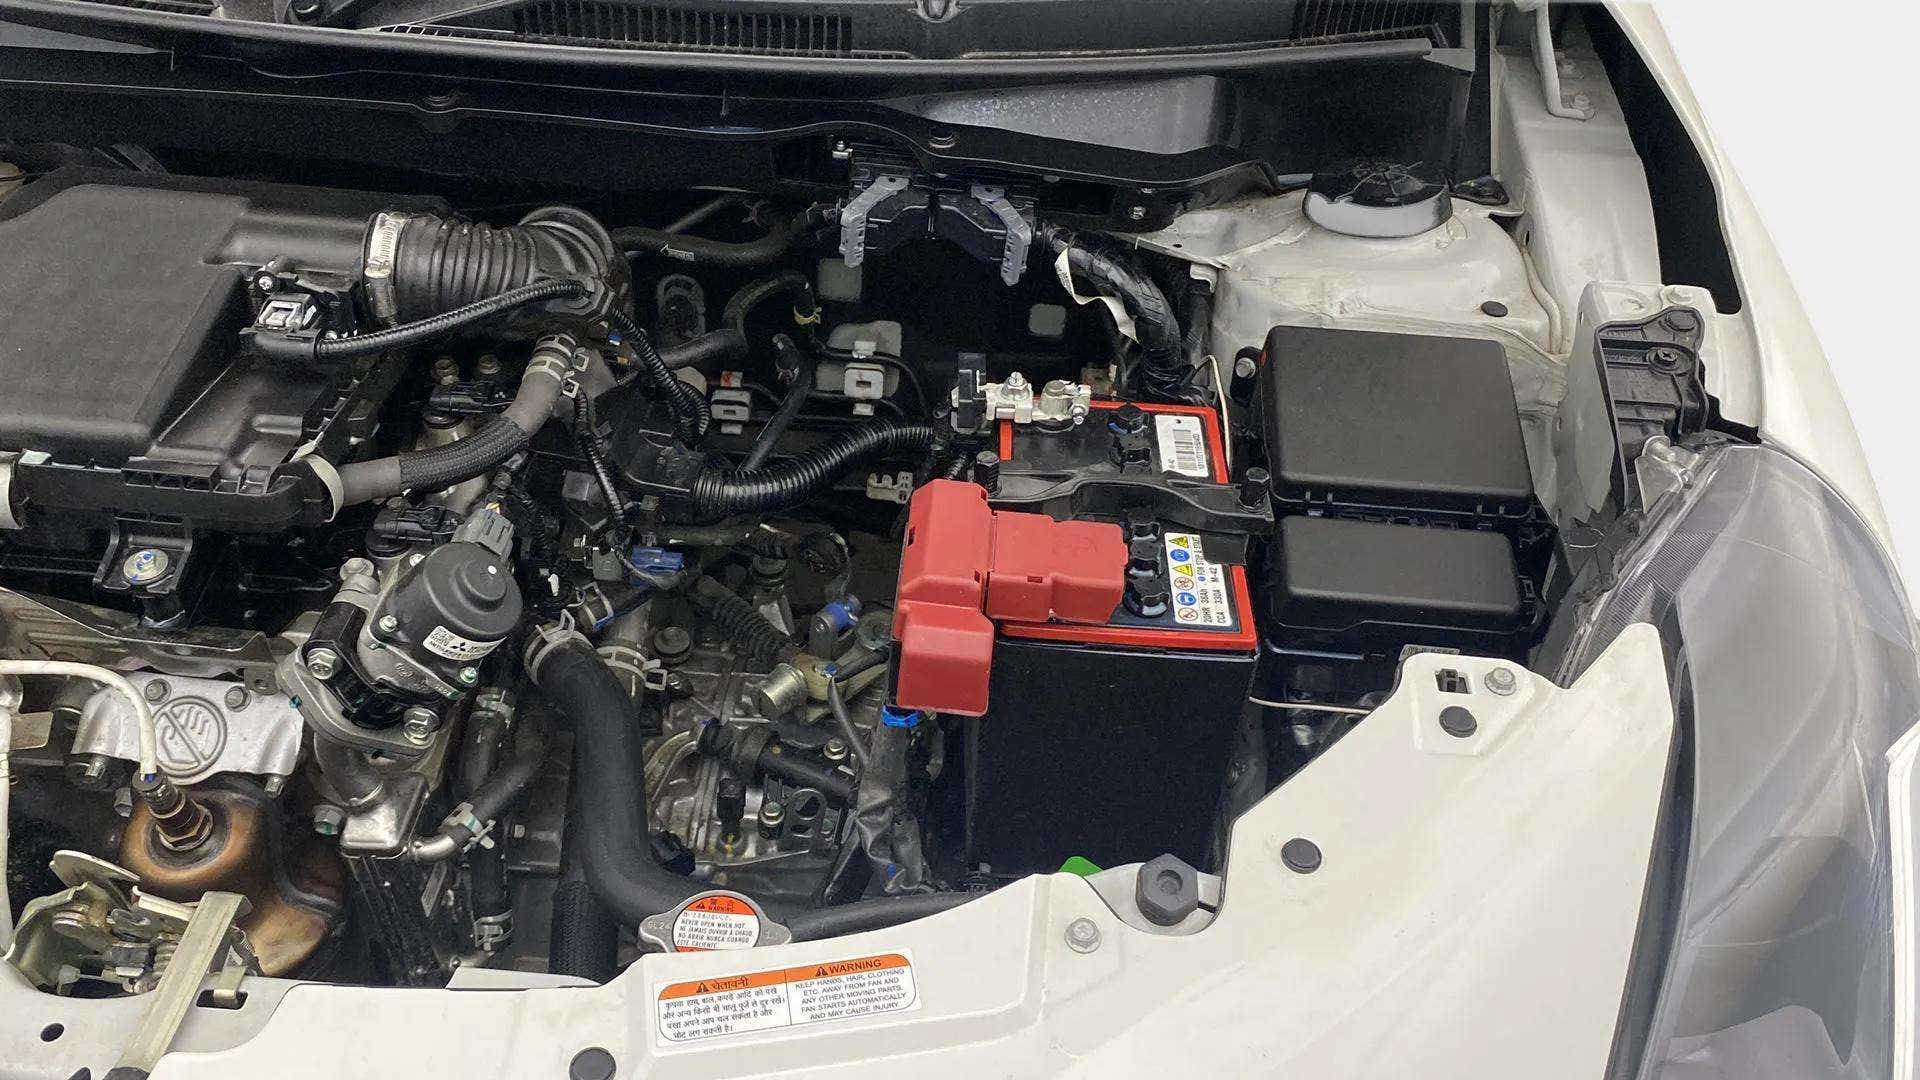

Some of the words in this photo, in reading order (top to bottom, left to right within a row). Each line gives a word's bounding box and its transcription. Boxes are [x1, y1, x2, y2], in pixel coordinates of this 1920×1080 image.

[1208, 567, 1218, 582] M-42
[1213, 590, 1222, 604] 330A
[1202, 607, 1212, 623] 20HR
[1217, 612, 1226, 624] CCA
[829, 959, 882, 974] WARNING
[711, 976, 748, 990] चेतावनी
[817, 978, 842, 986] HANDS,
[846, 974, 866, 982] HAIR,
[868, 968, 904, 979] CLOTHING
[822, 985, 842, 994] AWAY
[844, 982, 866, 990] FROM
[884, 976, 900, 984] AND
[818, 993, 844, 1002] OTHER
[846, 988, 876, 998] MOVING
[818, 1001, 846, 1011] STARTS
[848, 992, 907, 1006] AUTOMATICALLY
[662, 1010, 674, 1020] और
[694, 1005, 710, 1015] किसी
[760, 999, 769, 1008] दूर
[846, 1006, 870, 1014] CAUSE
[684, 1018, 700, 1027] अपने
[702, 1016, 715, 1024] आप
[732, 1012, 752, 1021] सकता
[760, 1008, 773, 1017] और
[703, 1025, 722, 1035] सकती
